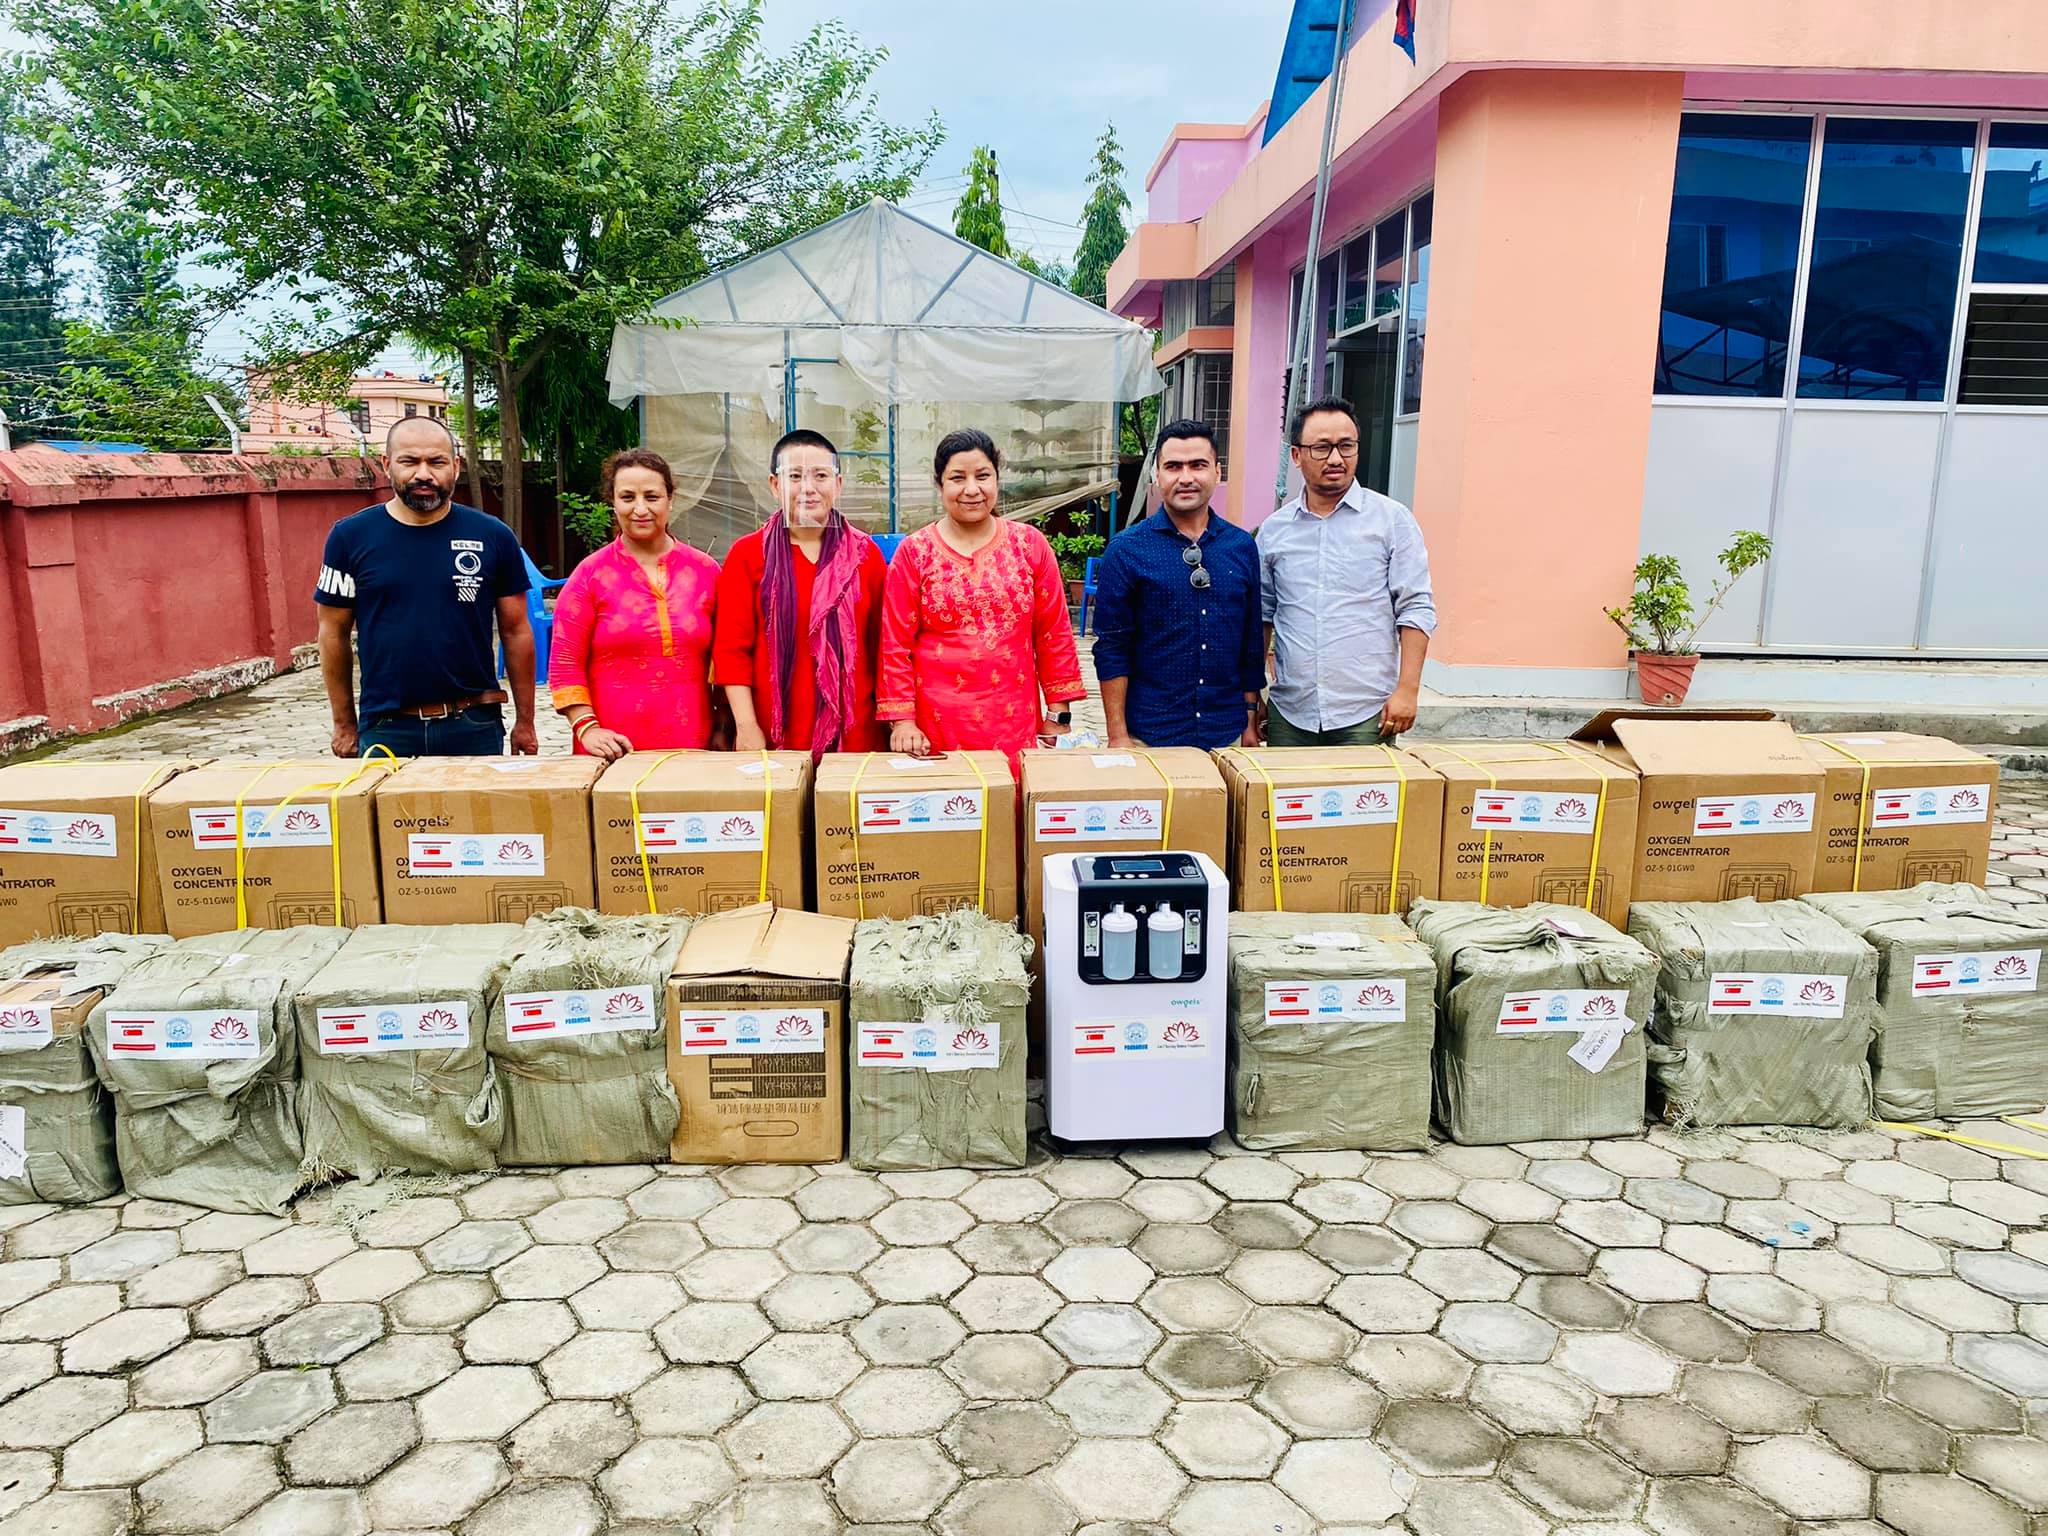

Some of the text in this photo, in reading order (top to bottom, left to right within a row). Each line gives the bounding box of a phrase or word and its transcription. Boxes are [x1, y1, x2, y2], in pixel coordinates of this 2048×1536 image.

[1833, 790, 1874, 806] owgl
[1653, 799, 1695, 815] owgel
[393, 816, 450, 833] owgels
[1829, 828, 1871, 837] OXYGN
[1647, 836, 1691, 845] OXYGEN
[1828, 838, 1910, 848] CONCNTRATOR
[1646, 847, 1730, 857] CONCENTRATOR
[171, 866, 222, 877] OXYGEN
[611, 867, 705, 877] CONCNTRATOR
[827, 862, 875, 874] OXYGEN
[828, 871, 920, 886] CONCENTRATOR
[1260, 875, 1313, 884] OZ--01GW0
[398, 886, 457, 896] OZ-5-01GW0
[176, 896, 236, 906] OZ-5-01GW0
